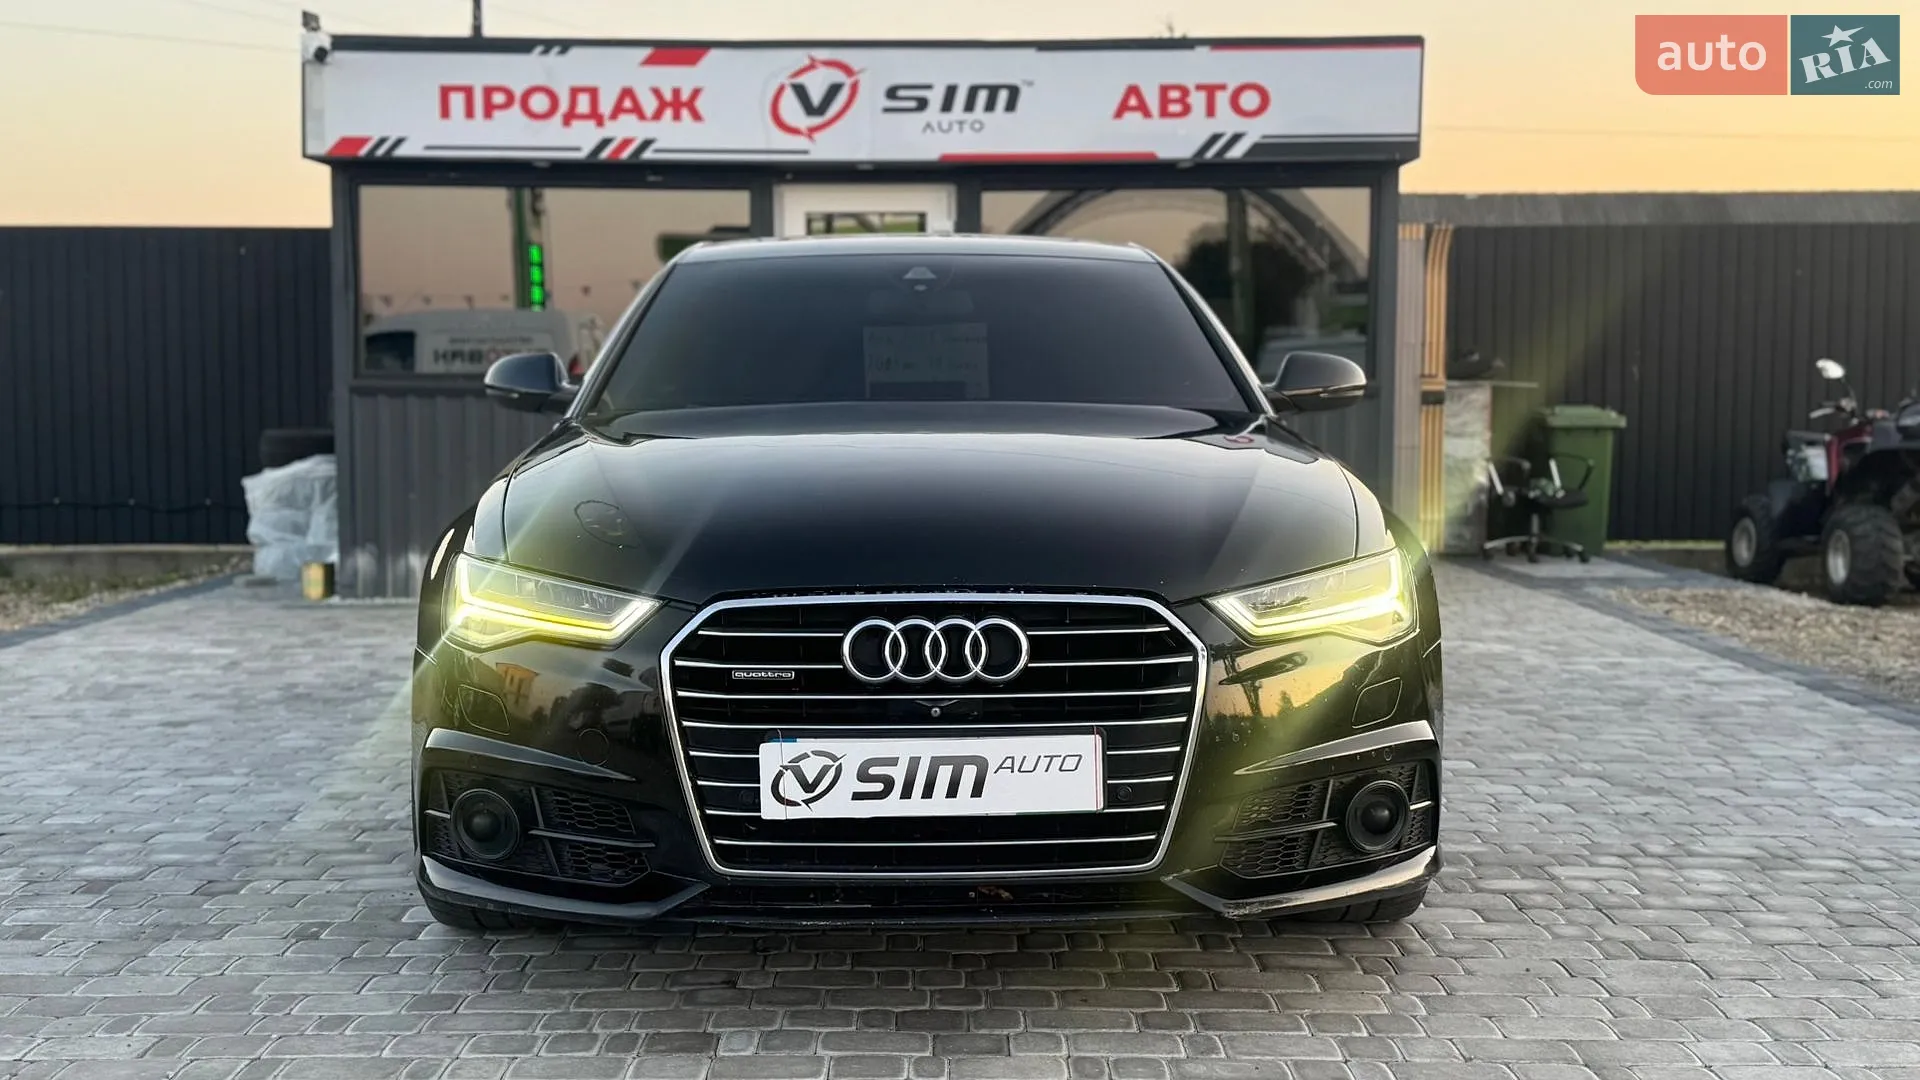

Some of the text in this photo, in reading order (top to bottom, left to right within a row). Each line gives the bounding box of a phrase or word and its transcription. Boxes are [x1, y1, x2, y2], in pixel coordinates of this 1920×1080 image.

[438, 84, 705, 129] ПРОДАЖ
[882, 83, 1021, 114] SIM
[1113, 82, 1271, 120] АВТО
[921, 118, 985, 134] AUTO
[734, 671, 792, 680] quattro
[850, 755, 990, 801] SIM
[993, 753, 1083, 775] AUTO
